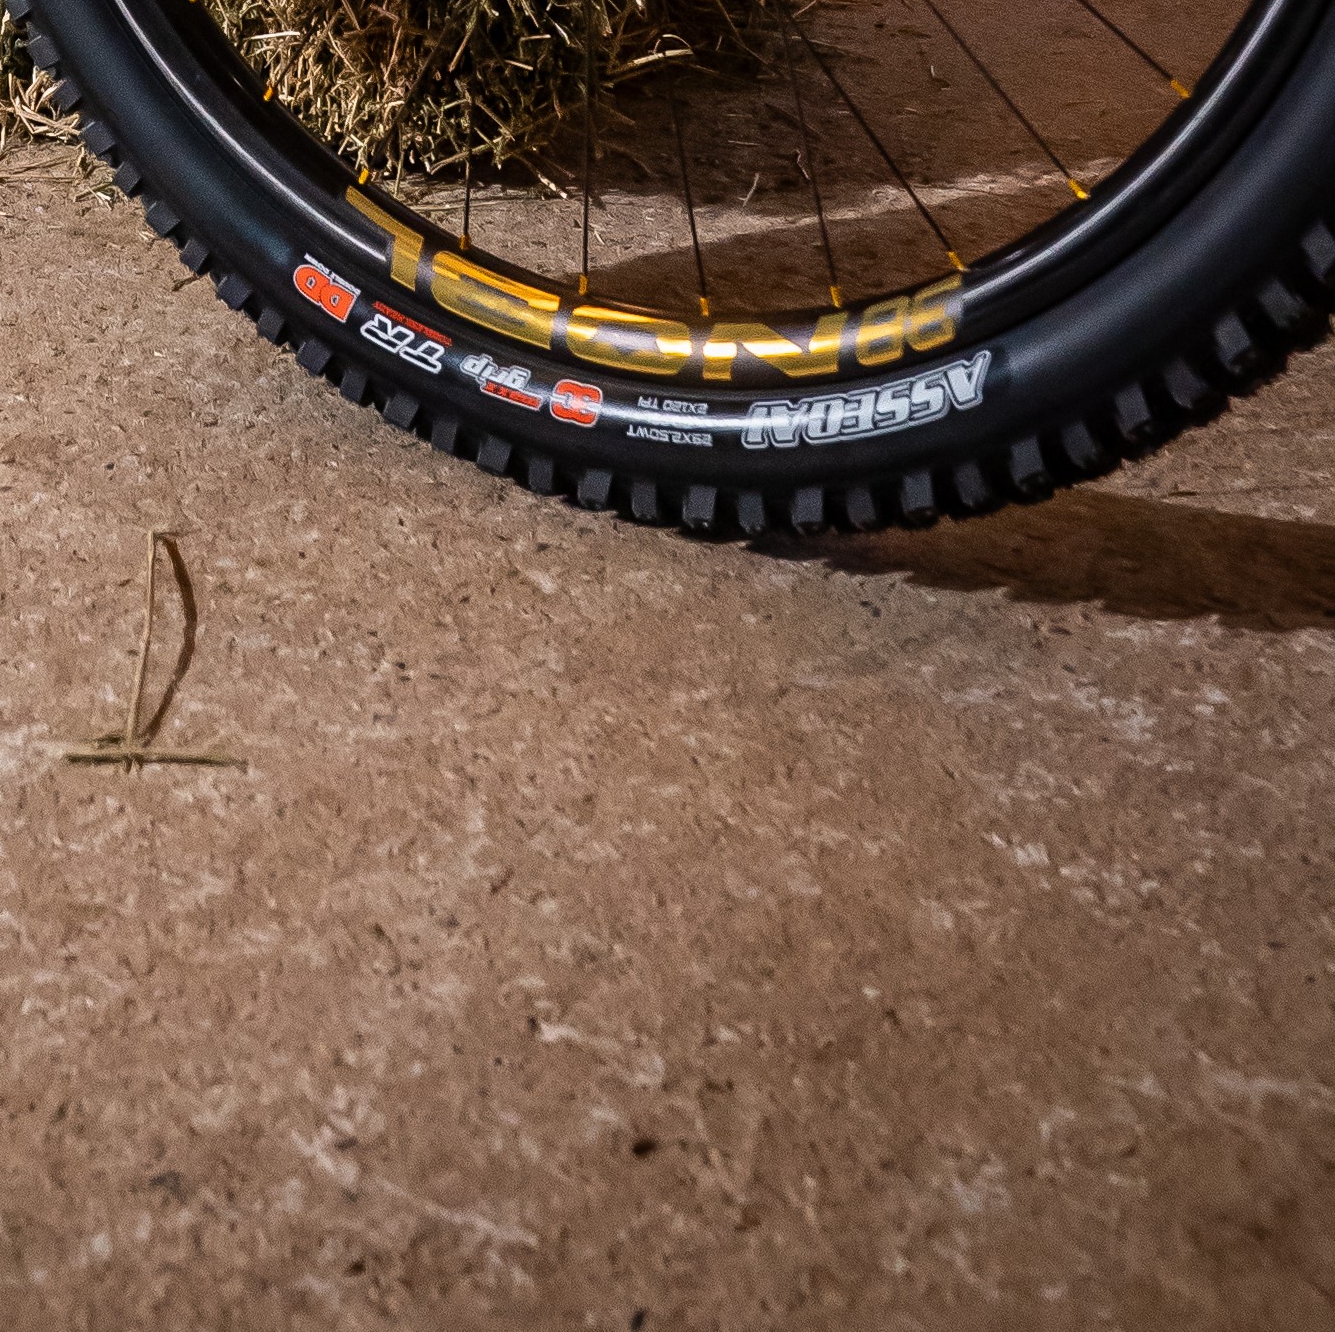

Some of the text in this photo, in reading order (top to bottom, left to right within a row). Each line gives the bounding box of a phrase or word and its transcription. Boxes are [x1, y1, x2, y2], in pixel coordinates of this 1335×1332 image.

[293, 264, 359, 323] DD
[360, 314, 446, 374] TR
[460, 353, 532, 391] grip
